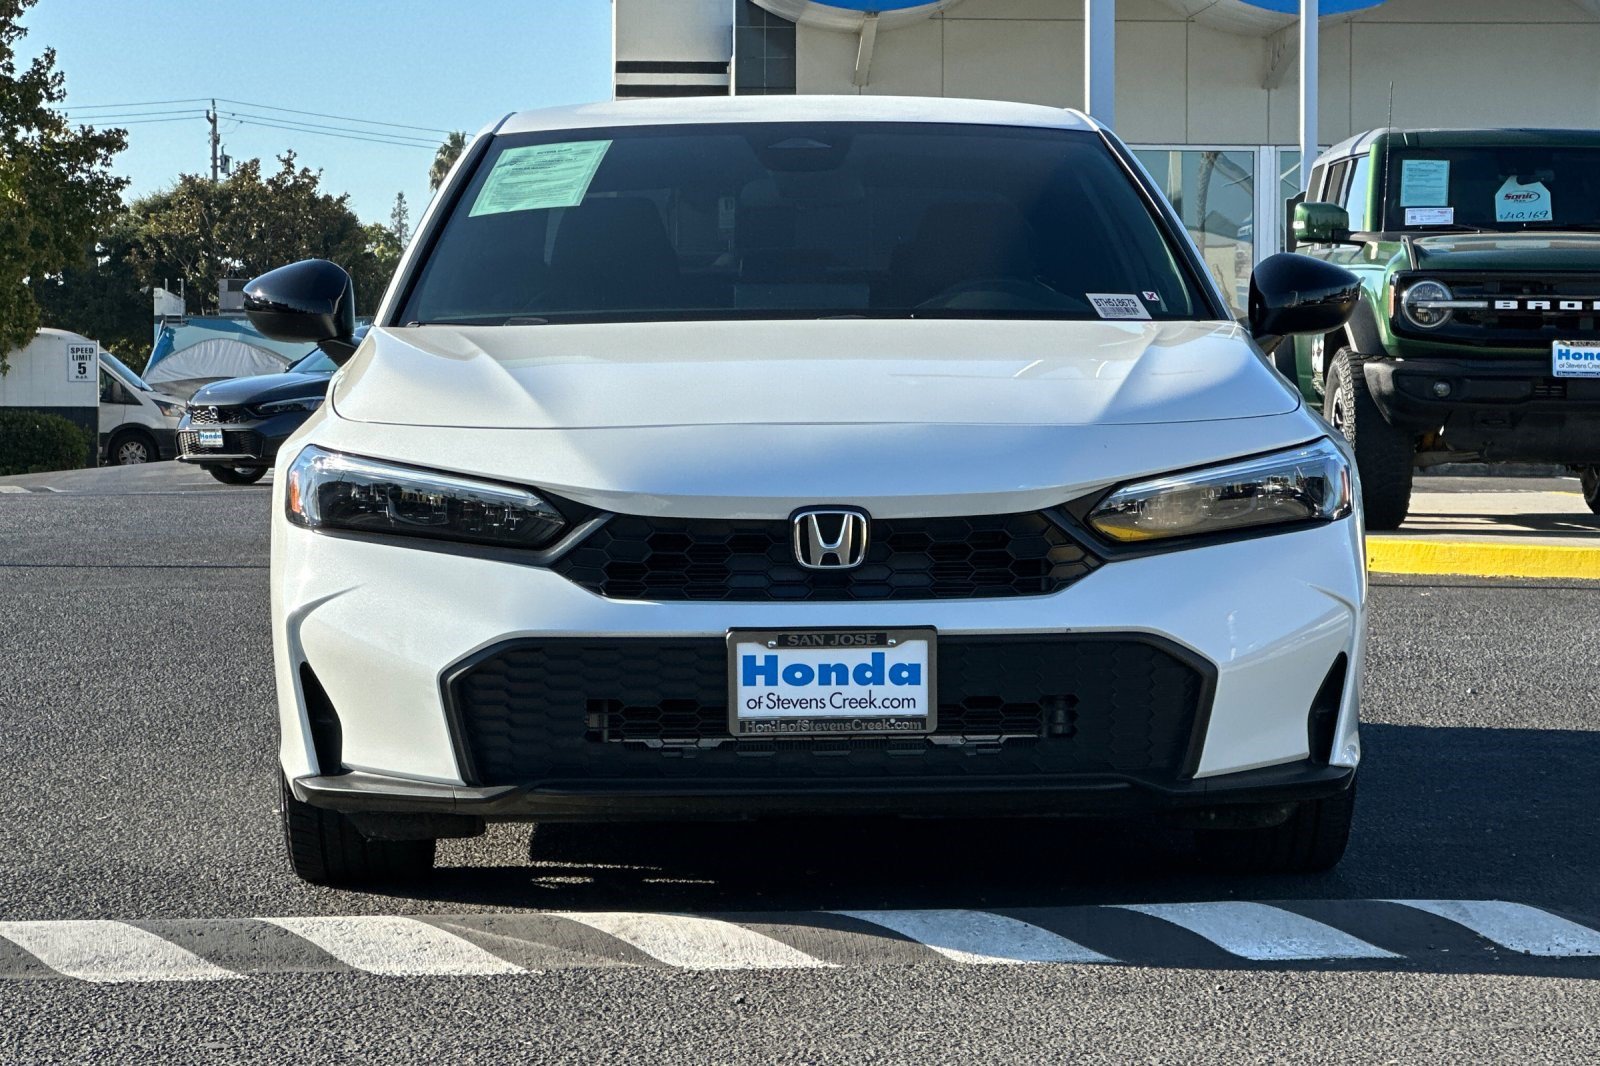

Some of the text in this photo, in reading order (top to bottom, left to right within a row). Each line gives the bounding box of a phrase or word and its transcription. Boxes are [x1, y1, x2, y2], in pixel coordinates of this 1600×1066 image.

[1504, 192, 1535, 200] Sonic
[77, 362, 87, 375] 5
[787, 634, 878, 646] SAN JOSE
[742, 652, 921, 686] Honda
[746, 689, 916, 709] of Stevens Creek.com
